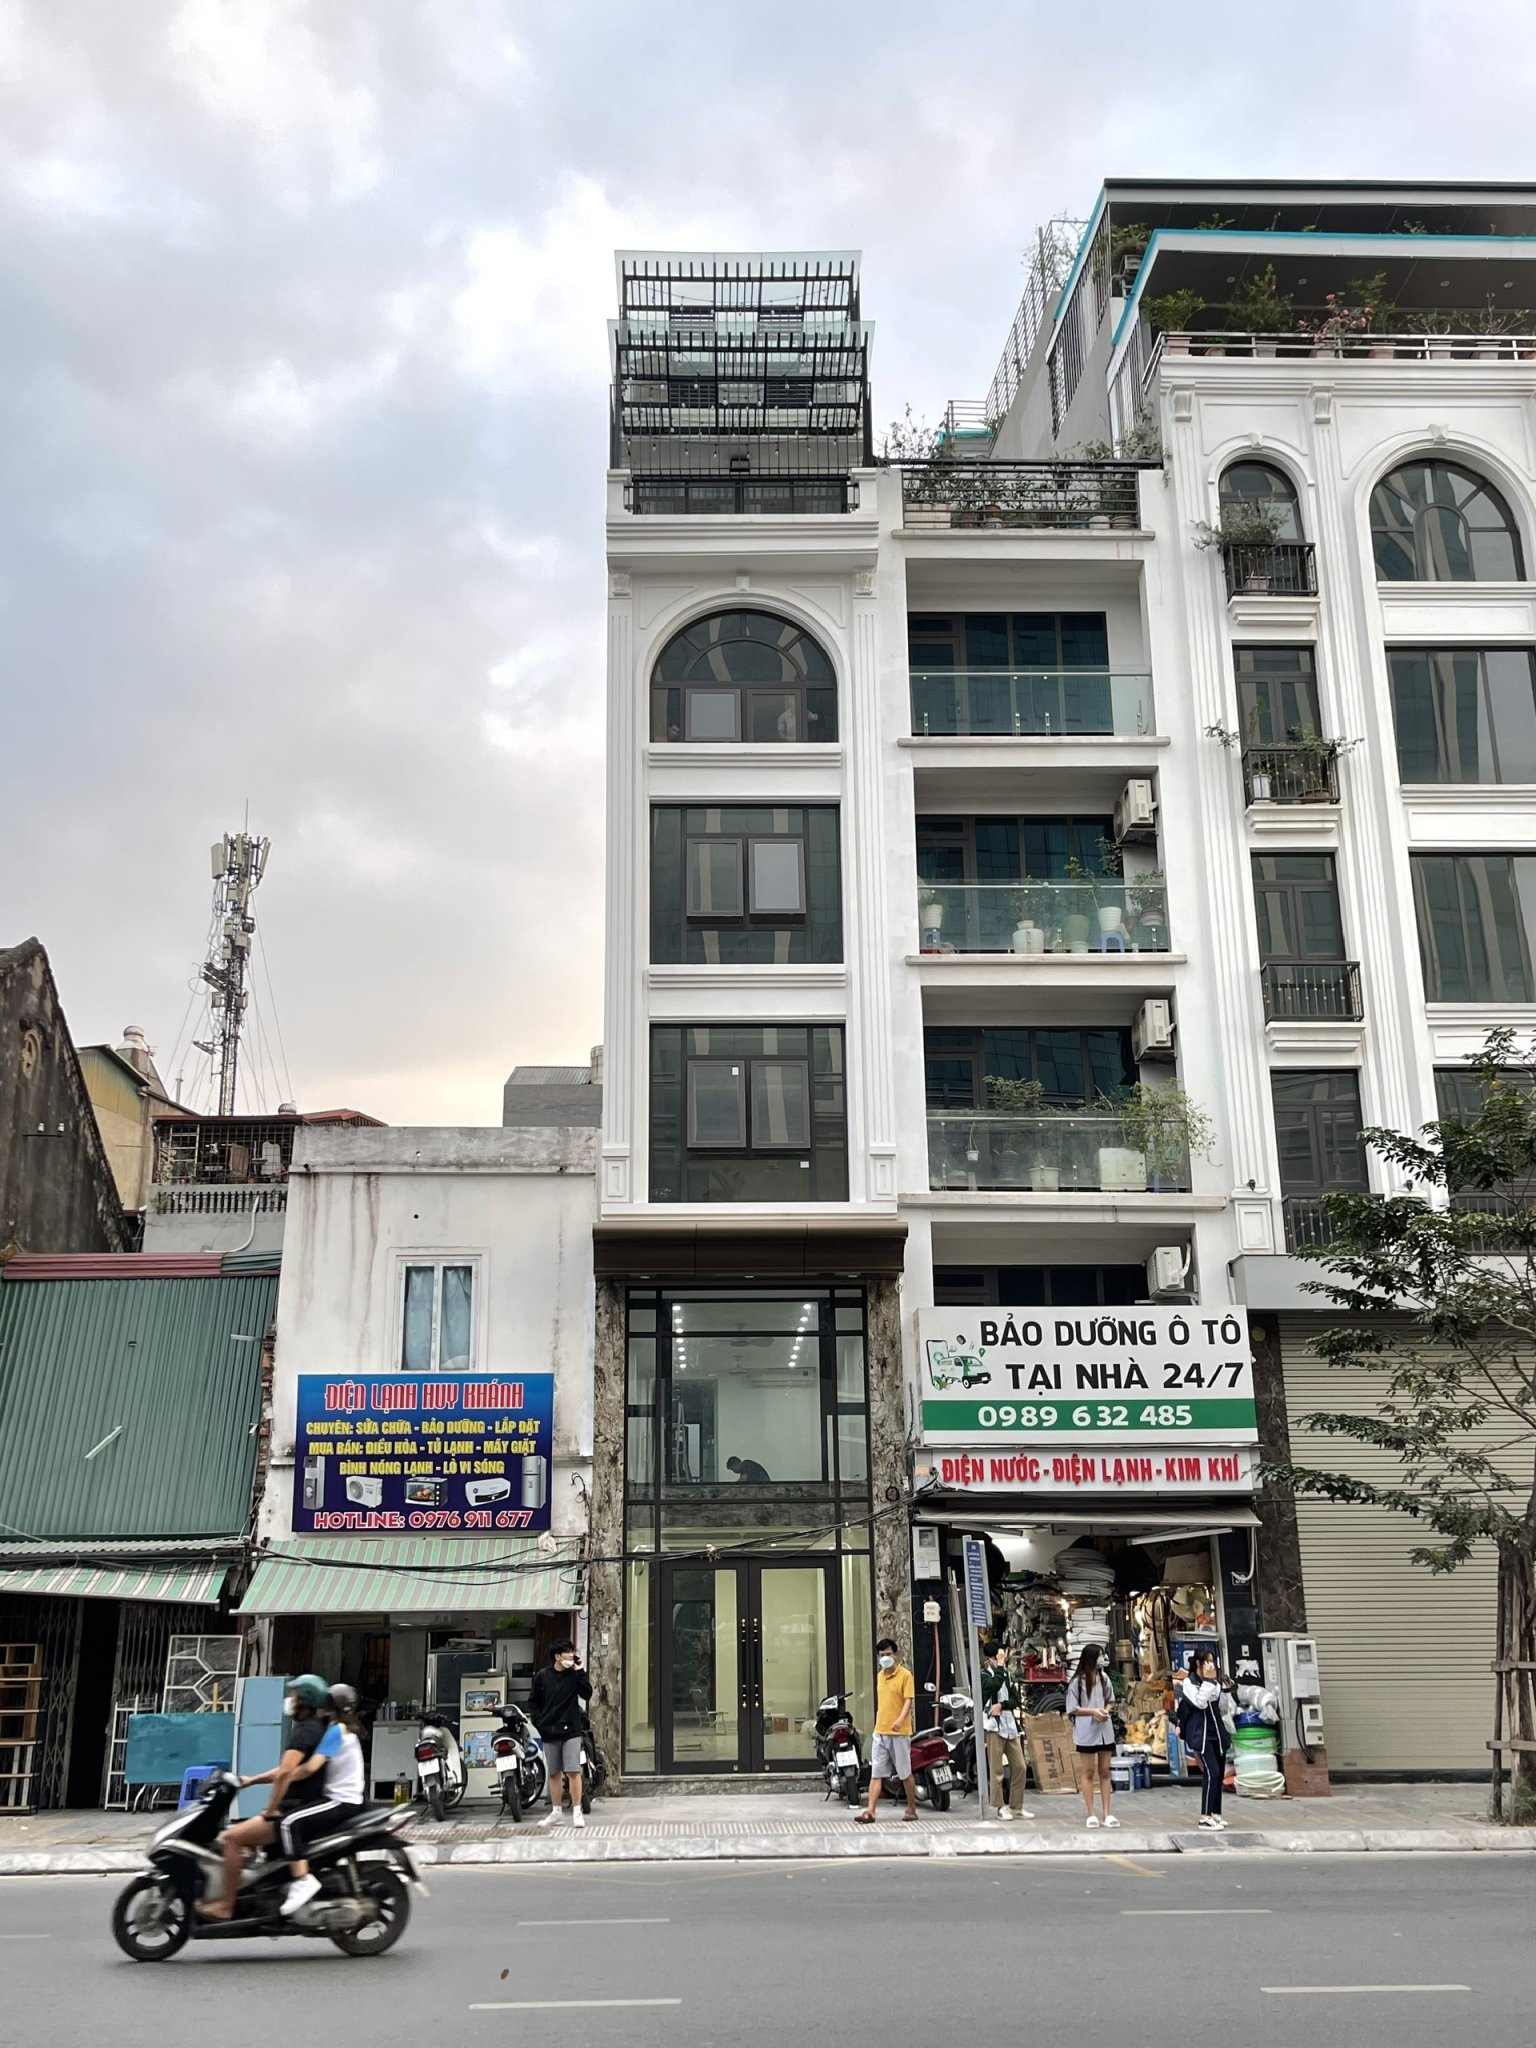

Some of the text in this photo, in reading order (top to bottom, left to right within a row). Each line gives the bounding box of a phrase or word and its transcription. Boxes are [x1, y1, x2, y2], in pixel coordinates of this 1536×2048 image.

[979, 1313, 1241, 1347] BẢO DƯỠNG Ô TÔ
[1005, 1357, 1244, 1396] TẠI NHÀ 24/7
[325, 1378, 524, 1414] ĐIỆN LẠNH HUY KHÁNH
[306, 1420, 354, 1435] CHUYÊN:
[355, 1417, 379, 1434] SỬA
[381, 1420, 412, 1434] CHỮA
[421, 1417, 444, 1434] BẢO
[446, 1418, 485, 1434] DƯỠNG
[494, 1416, 517, 1434] LẮP
[518, 1418, 540, 1436] ĐẶT
[978, 1405, 1193, 1427] 0989 632 485
[309, 1442, 334, 1455] MUA
[336, 1439, 364, 1455] BÁN:
[365, 1437, 392, 1454] ĐIỀU
[394, 1438, 418, 1454] HÒA
[427, 1437, 442, 1454] TỦ
[443, 1440, 474, 1456] LẠNH
[483, 1438, 509, 1454] MÁY
[511, 1438, 536, 1456] GIẶT
[340, 1459, 367, 1475] BÌNH
[369, 1459, 402, 1475] NÓNG
[403, 1461, 434, 1477] LẠNH
[443, 1458, 458, 1474] LÒ
[459, 1461, 472, 1474] VI
[473, 1458, 505, 1474] SÓNG
[942, 1454, 984, 1486] ĐIỆN
[990, 1453, 1040, 1481] NƯỚC
[1052, 1453, 1096, 1485] ĐIỆN
[1101, 1458, 1153, 1486] LẠNH
[1165, 1457, 1201, 1480] KIM
[1207, 1453, 1240, 1480] KHÍ
[313, 1511, 533, 1529] HOTLINE: 0976 911 677
